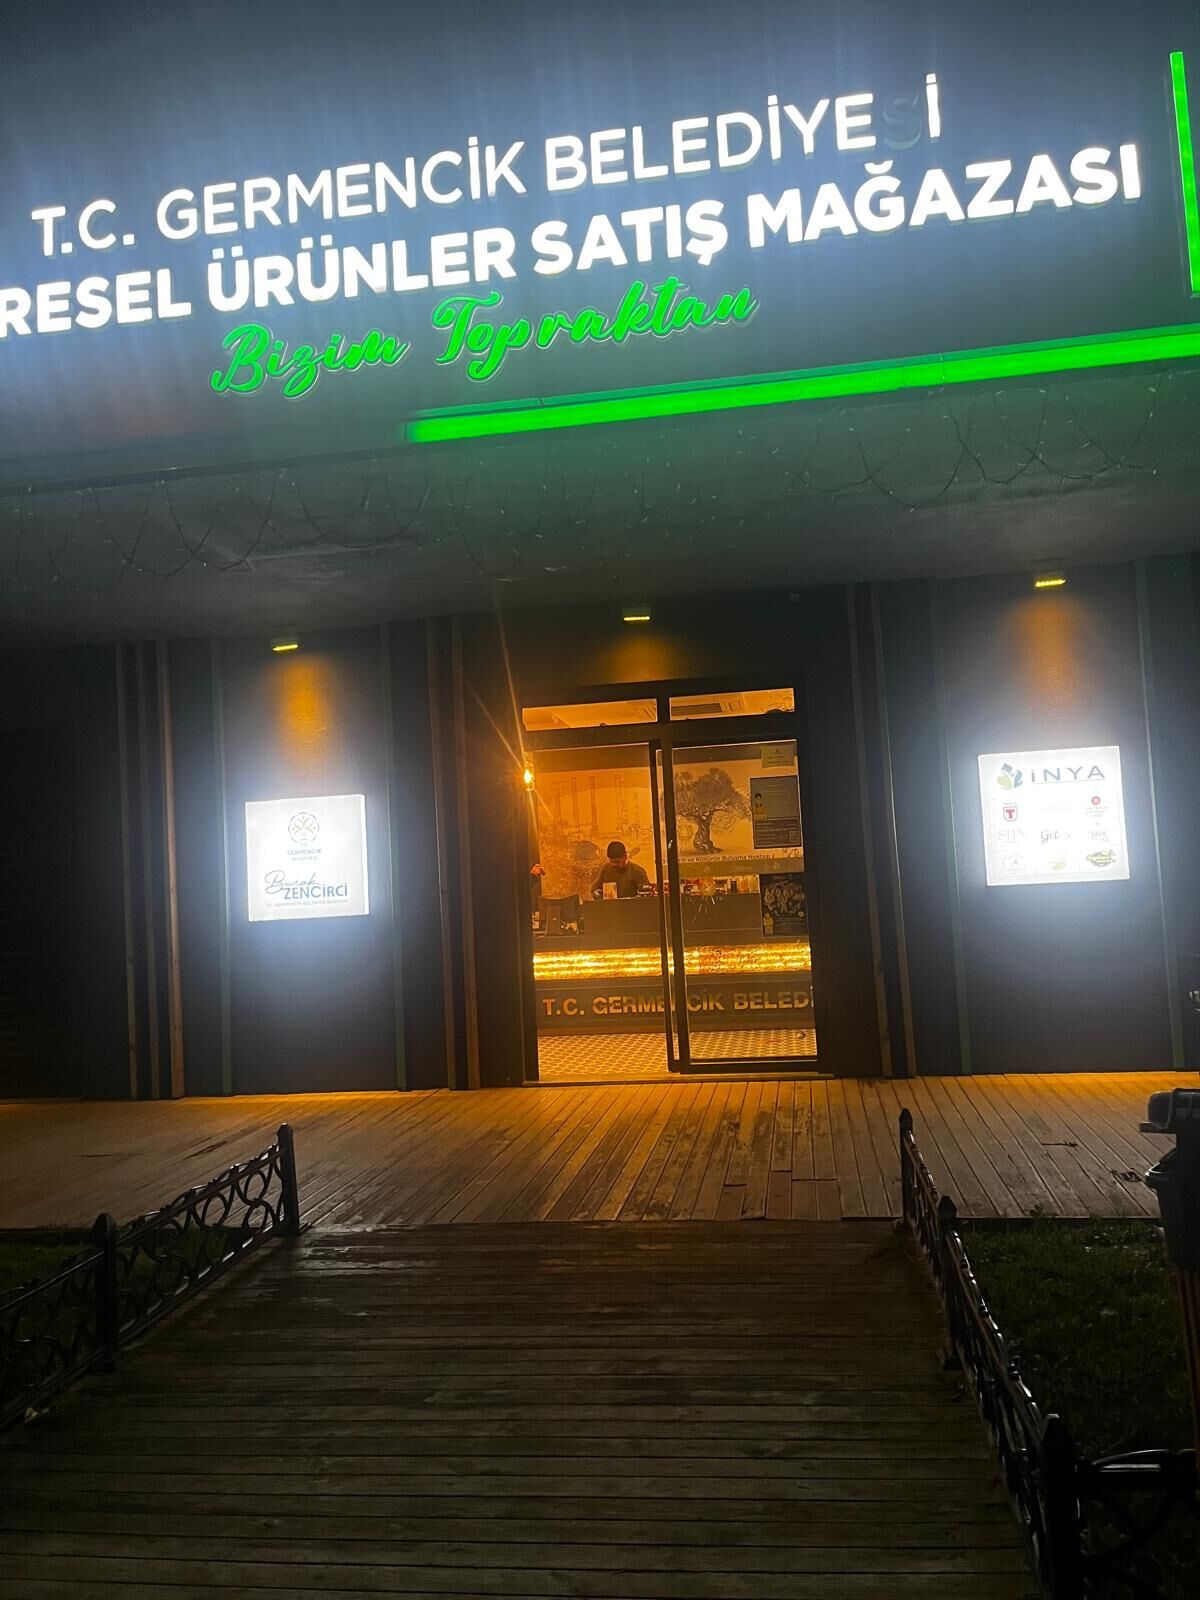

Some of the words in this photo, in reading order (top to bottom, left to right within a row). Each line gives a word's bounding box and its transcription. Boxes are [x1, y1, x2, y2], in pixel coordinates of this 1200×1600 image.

[31, 199, 135, 256] T.C.
[156, 136, 527, 240] GERMENCİK
[545, 72, 942, 191] BELEDİYESİ
[0, 268, 192, 338] RESEL
[207, 227, 517, 312] ÜRÜNLER
[531, 199, 728, 276] SATIŞ
[747, 144, 1141, 248] MAĞAZASI
[210, 322, 406, 398] Bizim
[431, 276, 758, 381] Topraktan
[284, 882, 348, 900] ZENCİRCİ
[542, 996, 585, 1015] T.C.
